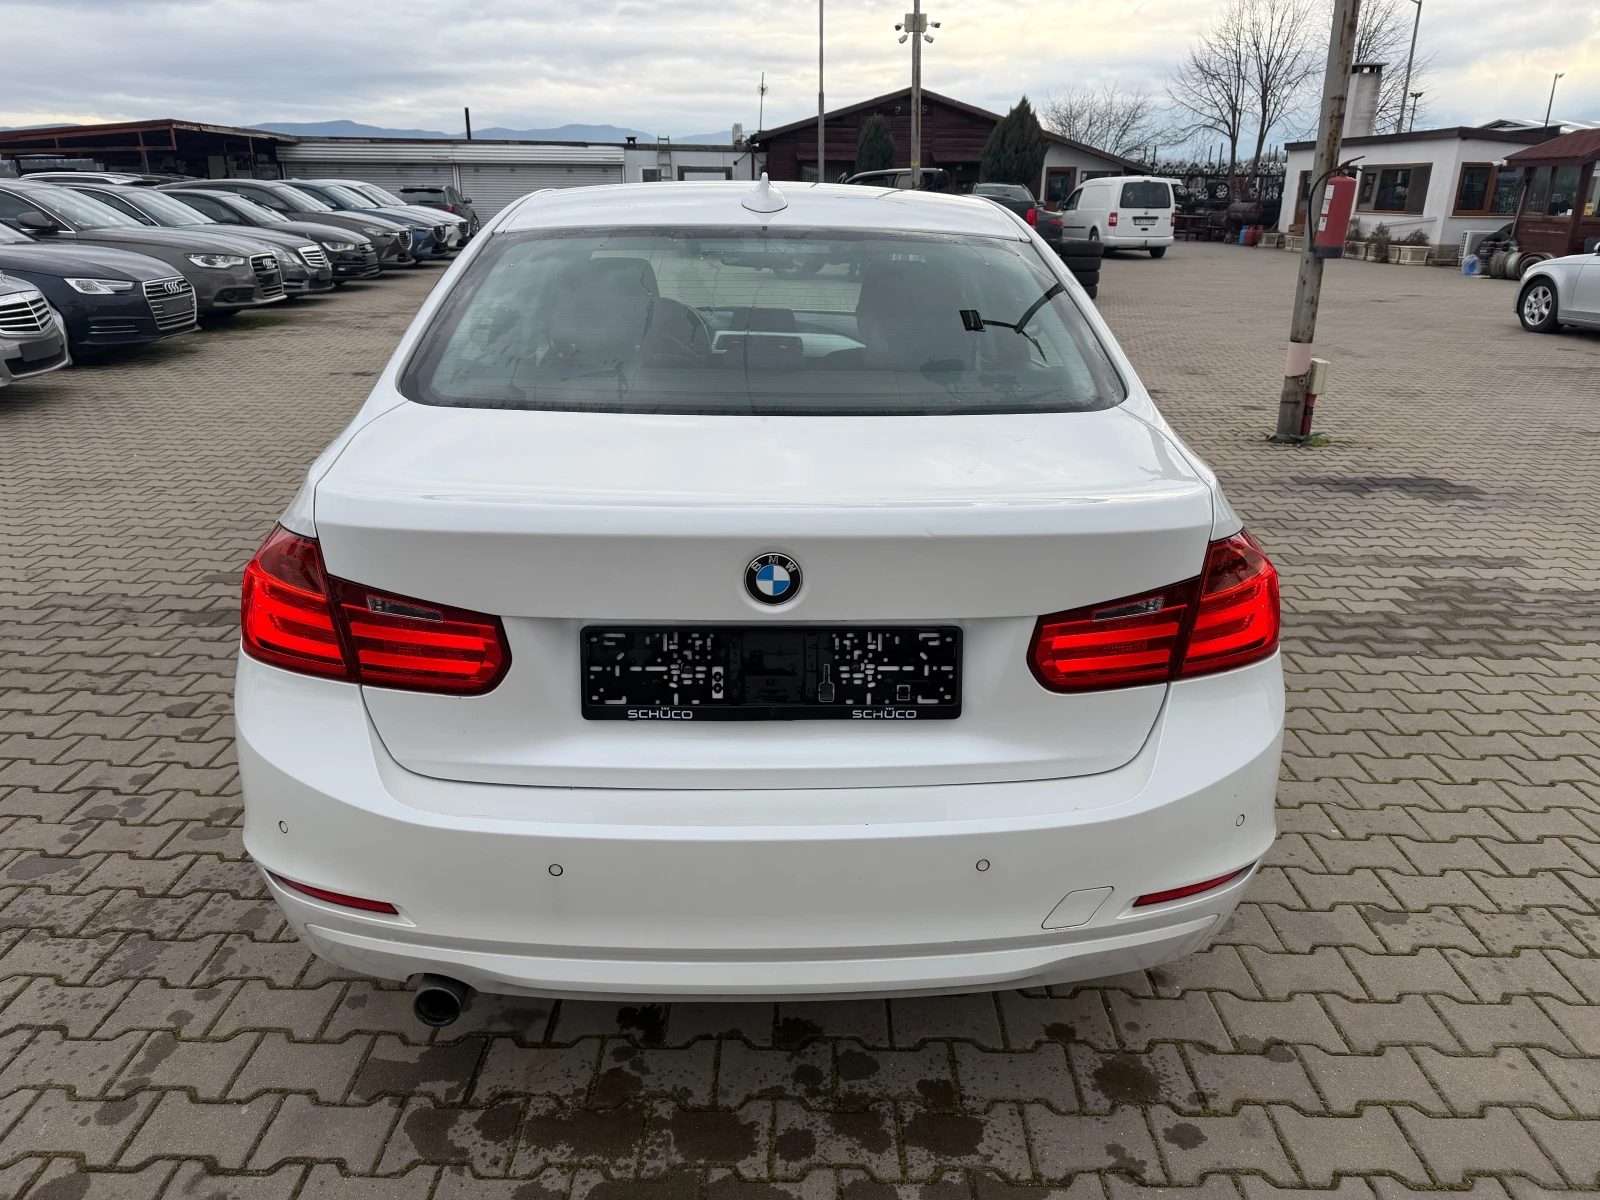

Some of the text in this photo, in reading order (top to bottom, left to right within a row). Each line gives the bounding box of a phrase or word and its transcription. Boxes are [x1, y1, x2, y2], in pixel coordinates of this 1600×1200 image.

[750, 555, 797, 573] BMW
[627, 706, 693, 719] SCHÜCO
[852, 707, 917, 719] SCHÜCO
